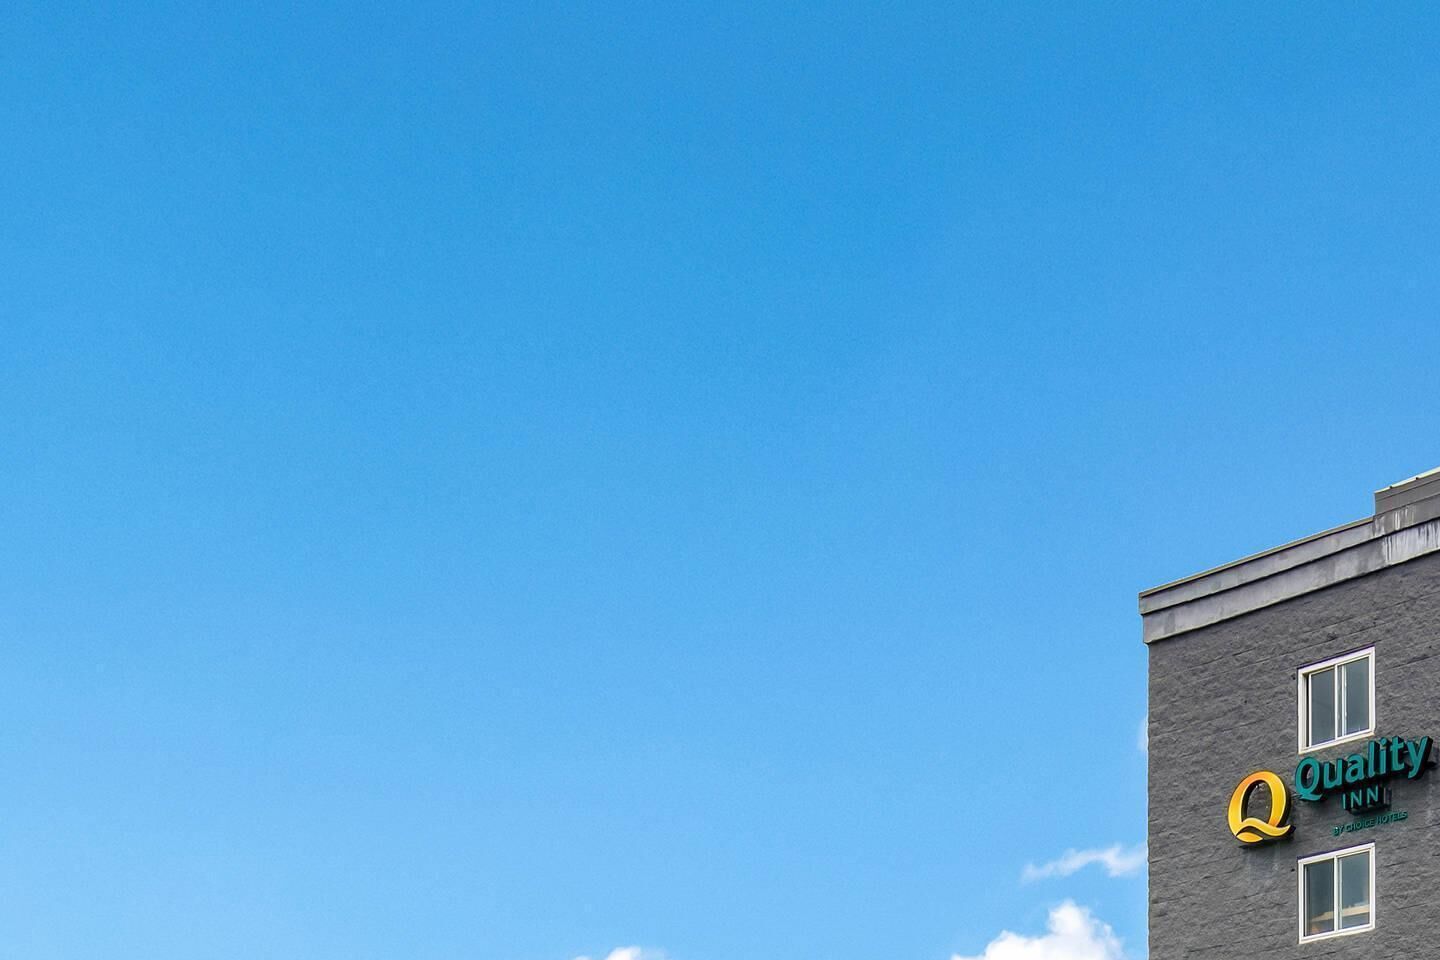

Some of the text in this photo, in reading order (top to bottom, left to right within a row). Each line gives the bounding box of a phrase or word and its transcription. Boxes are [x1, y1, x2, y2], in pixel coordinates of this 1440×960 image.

[1295, 735, 1432, 802] Quality
[1226, 769, 1294, 844] Q
[1341, 784, 1382, 811] INN
[1332, 811, 1408, 836] BY CHOICE HOTELS
